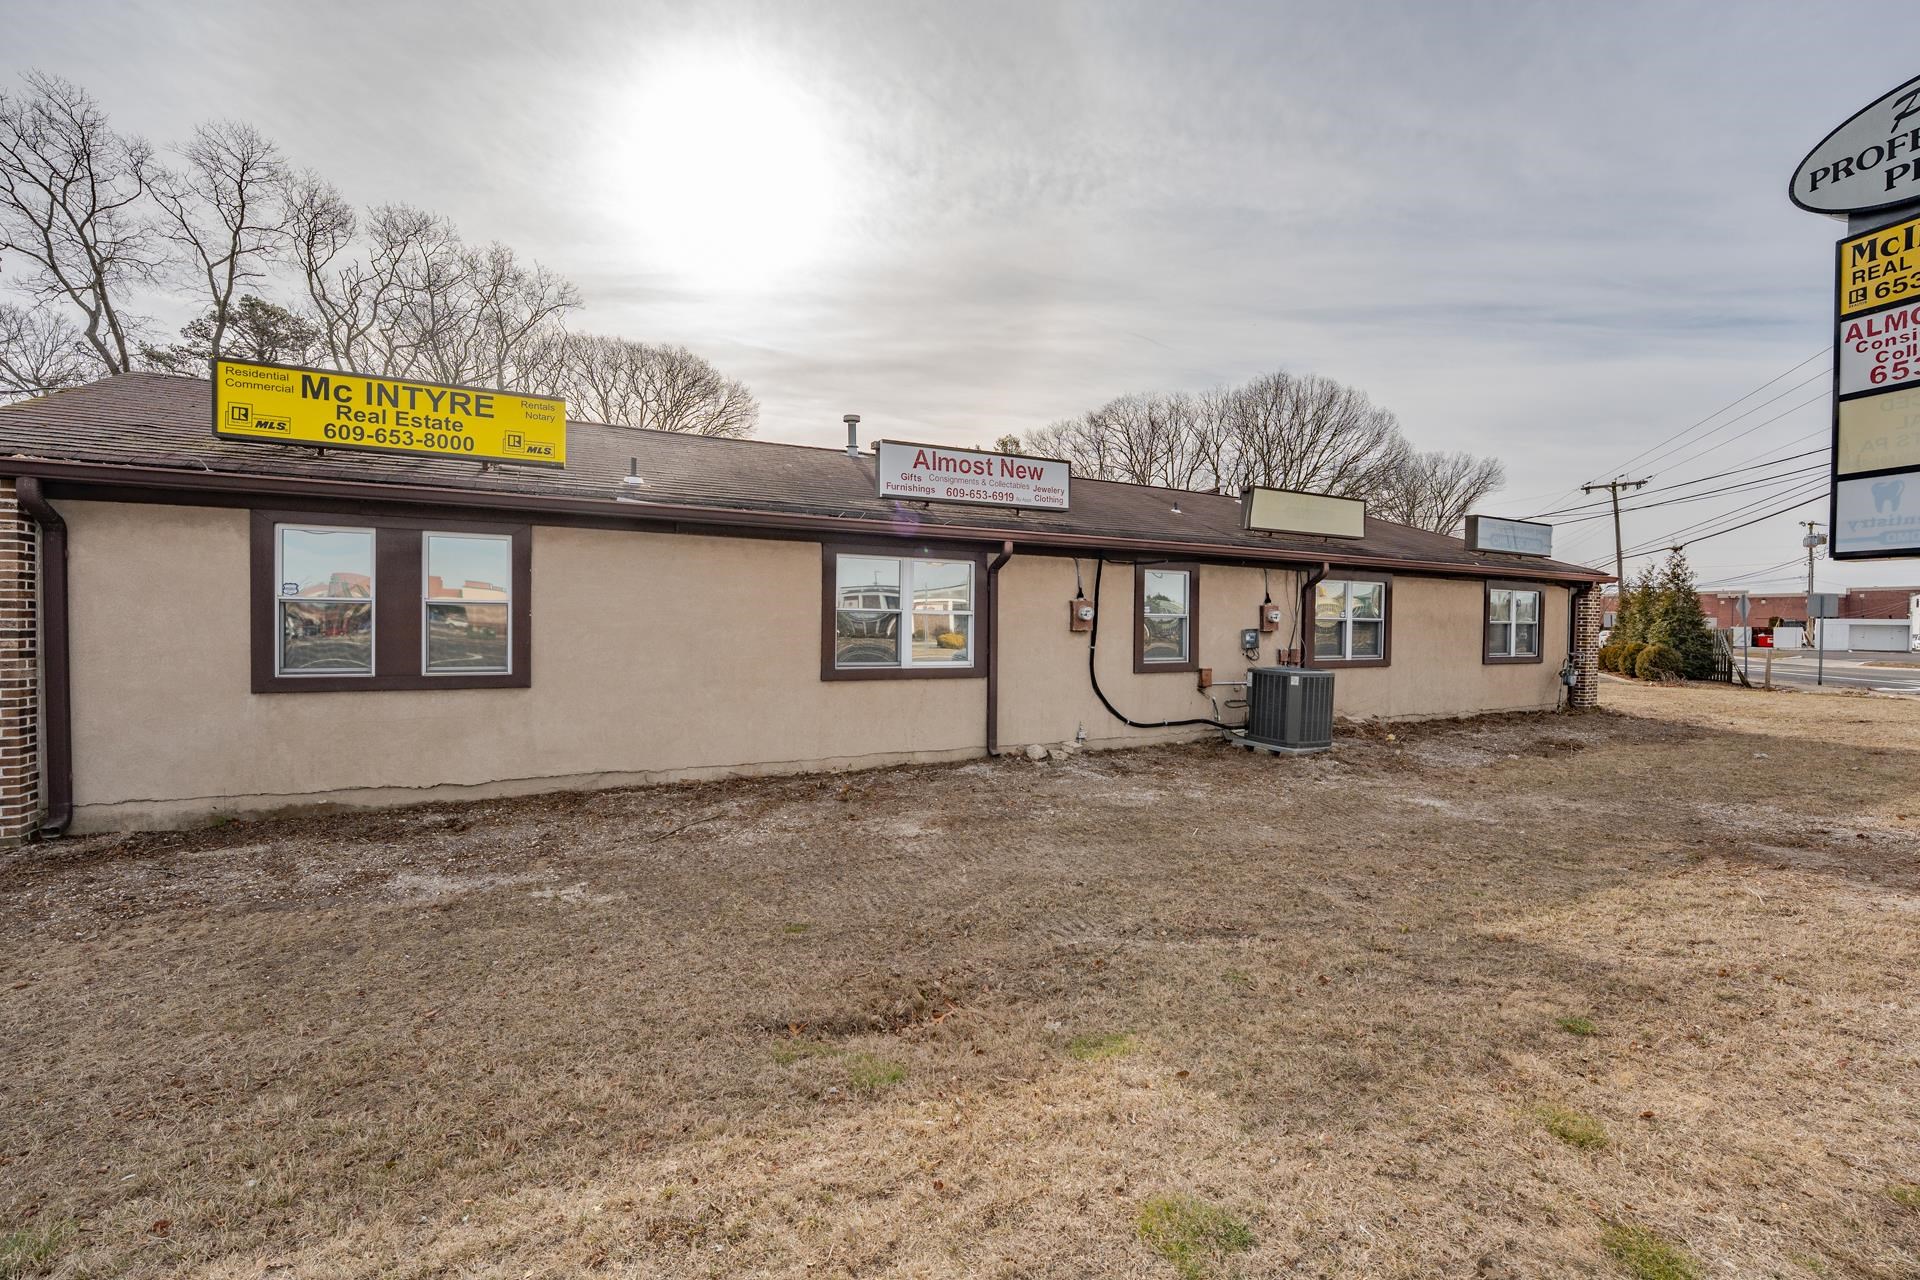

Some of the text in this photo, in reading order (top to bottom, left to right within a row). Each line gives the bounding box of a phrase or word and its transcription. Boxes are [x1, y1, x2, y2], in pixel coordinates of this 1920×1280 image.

[1851, 222, 1920, 268] McI
[1852, 256, 1912, 286] REAL
[225, 366, 289, 382] Residential
[225, 378, 294, 394] Commercial
[301, 374, 495, 419] Mc INTYRE
[520, 400, 556, 411] Rentals
[336, 405, 464, 432] Real Estate
[525, 411, 556, 423] Notary
[323, 422, 475, 452] 609-653-8000
[913, 449, 1044, 481] Almost New
[901, 472, 922, 483] Gifts
[929, 474, 1030, 491] Consignments & Collectables
[886, 481, 936, 495] Furnishings
[946, 487, 1015, 502] 609-653-6919
[1033, 485, 1065, 497] Jewelery
[1034, 494, 1064, 505] Clothing
